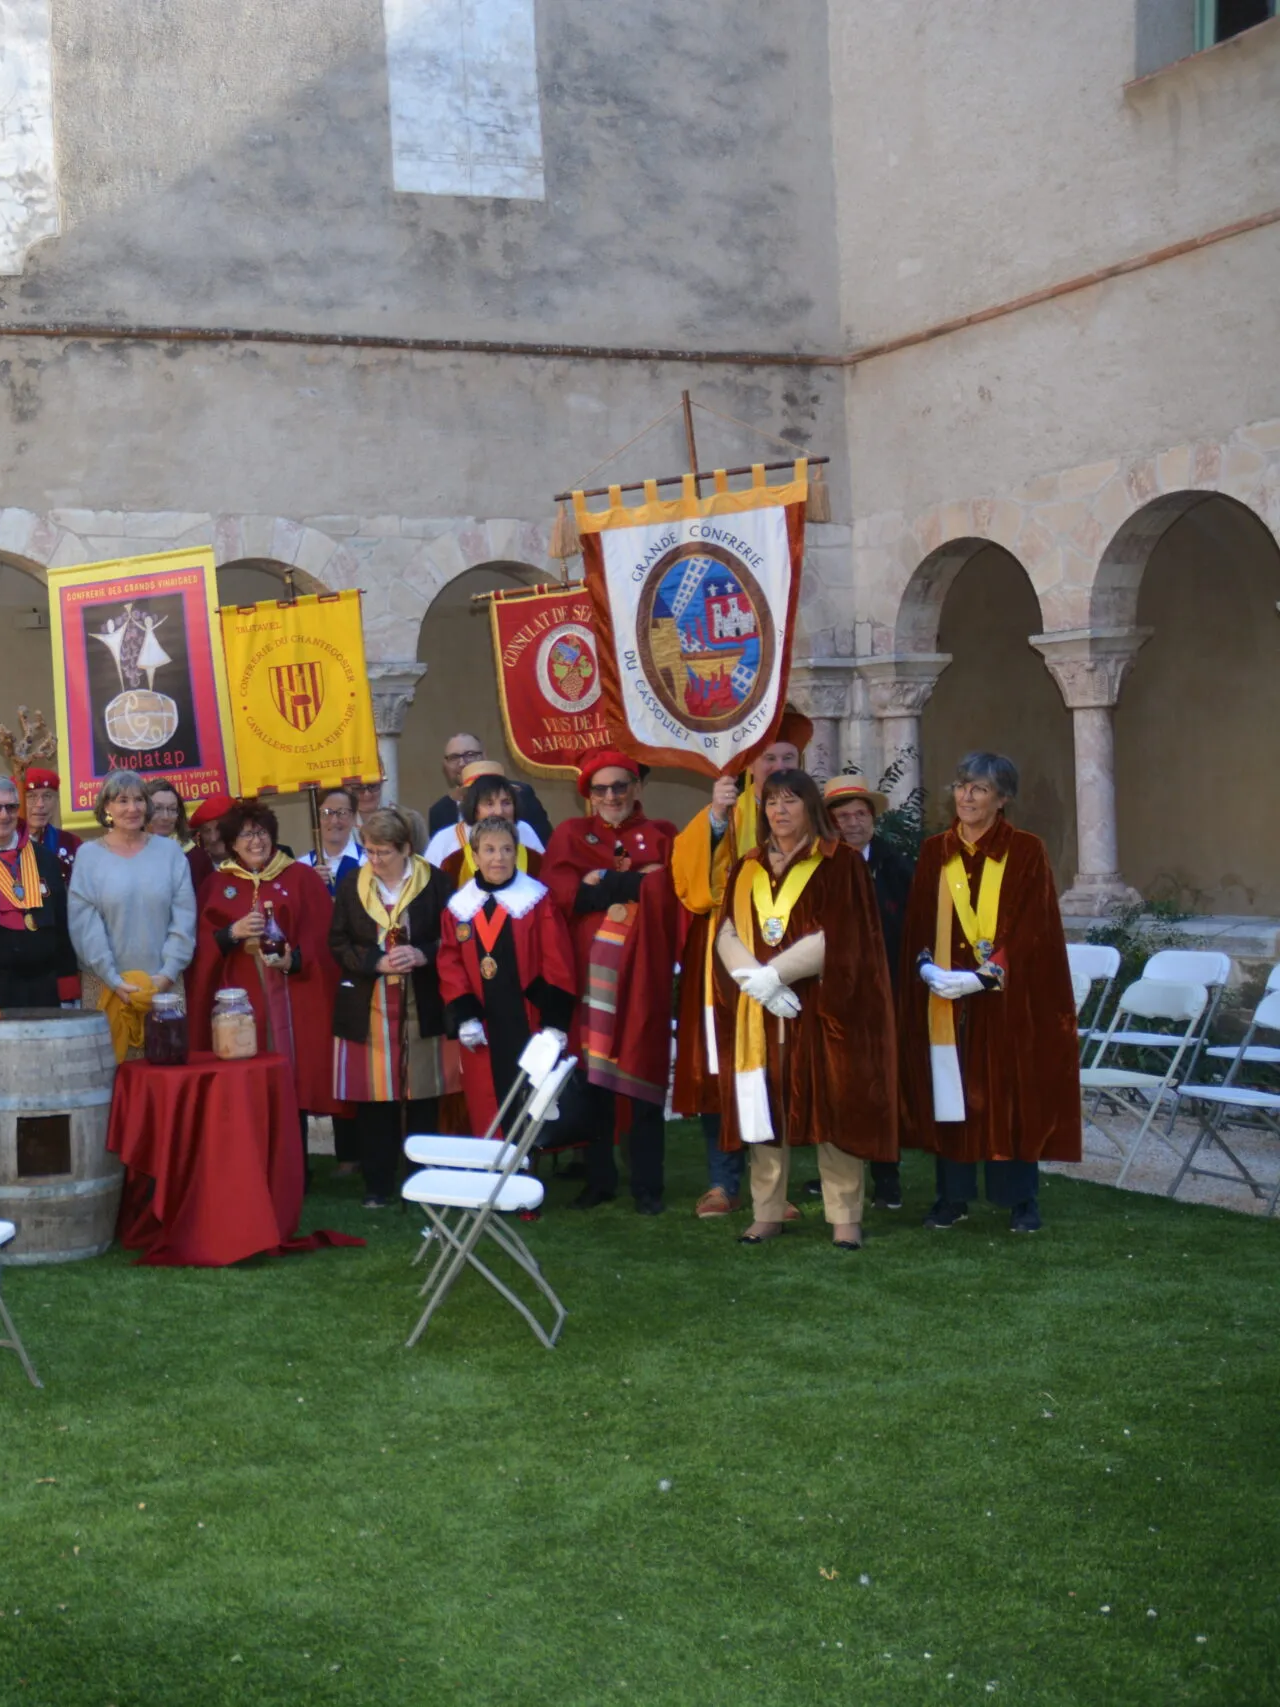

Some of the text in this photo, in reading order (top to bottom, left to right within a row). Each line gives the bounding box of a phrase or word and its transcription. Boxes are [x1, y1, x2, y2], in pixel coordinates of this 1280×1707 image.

[631, 525, 764, 582] GRANDE CONFRERIE
[124, 581, 156, 593] GRANDS
[503, 611, 552, 668] CONSULAT
[552, 605, 569, 624] DE
[240, 643, 274, 697] CONFRERIE
[275, 636, 288, 648] DU
[573, 714, 593, 731] DE
[623, 650, 638, 671] DU
[635, 679, 691, 742] CASSOULET
[704, 737, 720, 749] DE
[246, 715, 293, 754] CAVALLERS
[294, 744, 309, 754] DE
[309, 741, 325, 752] LA
[108, 750, 185, 771] Xuclatap
